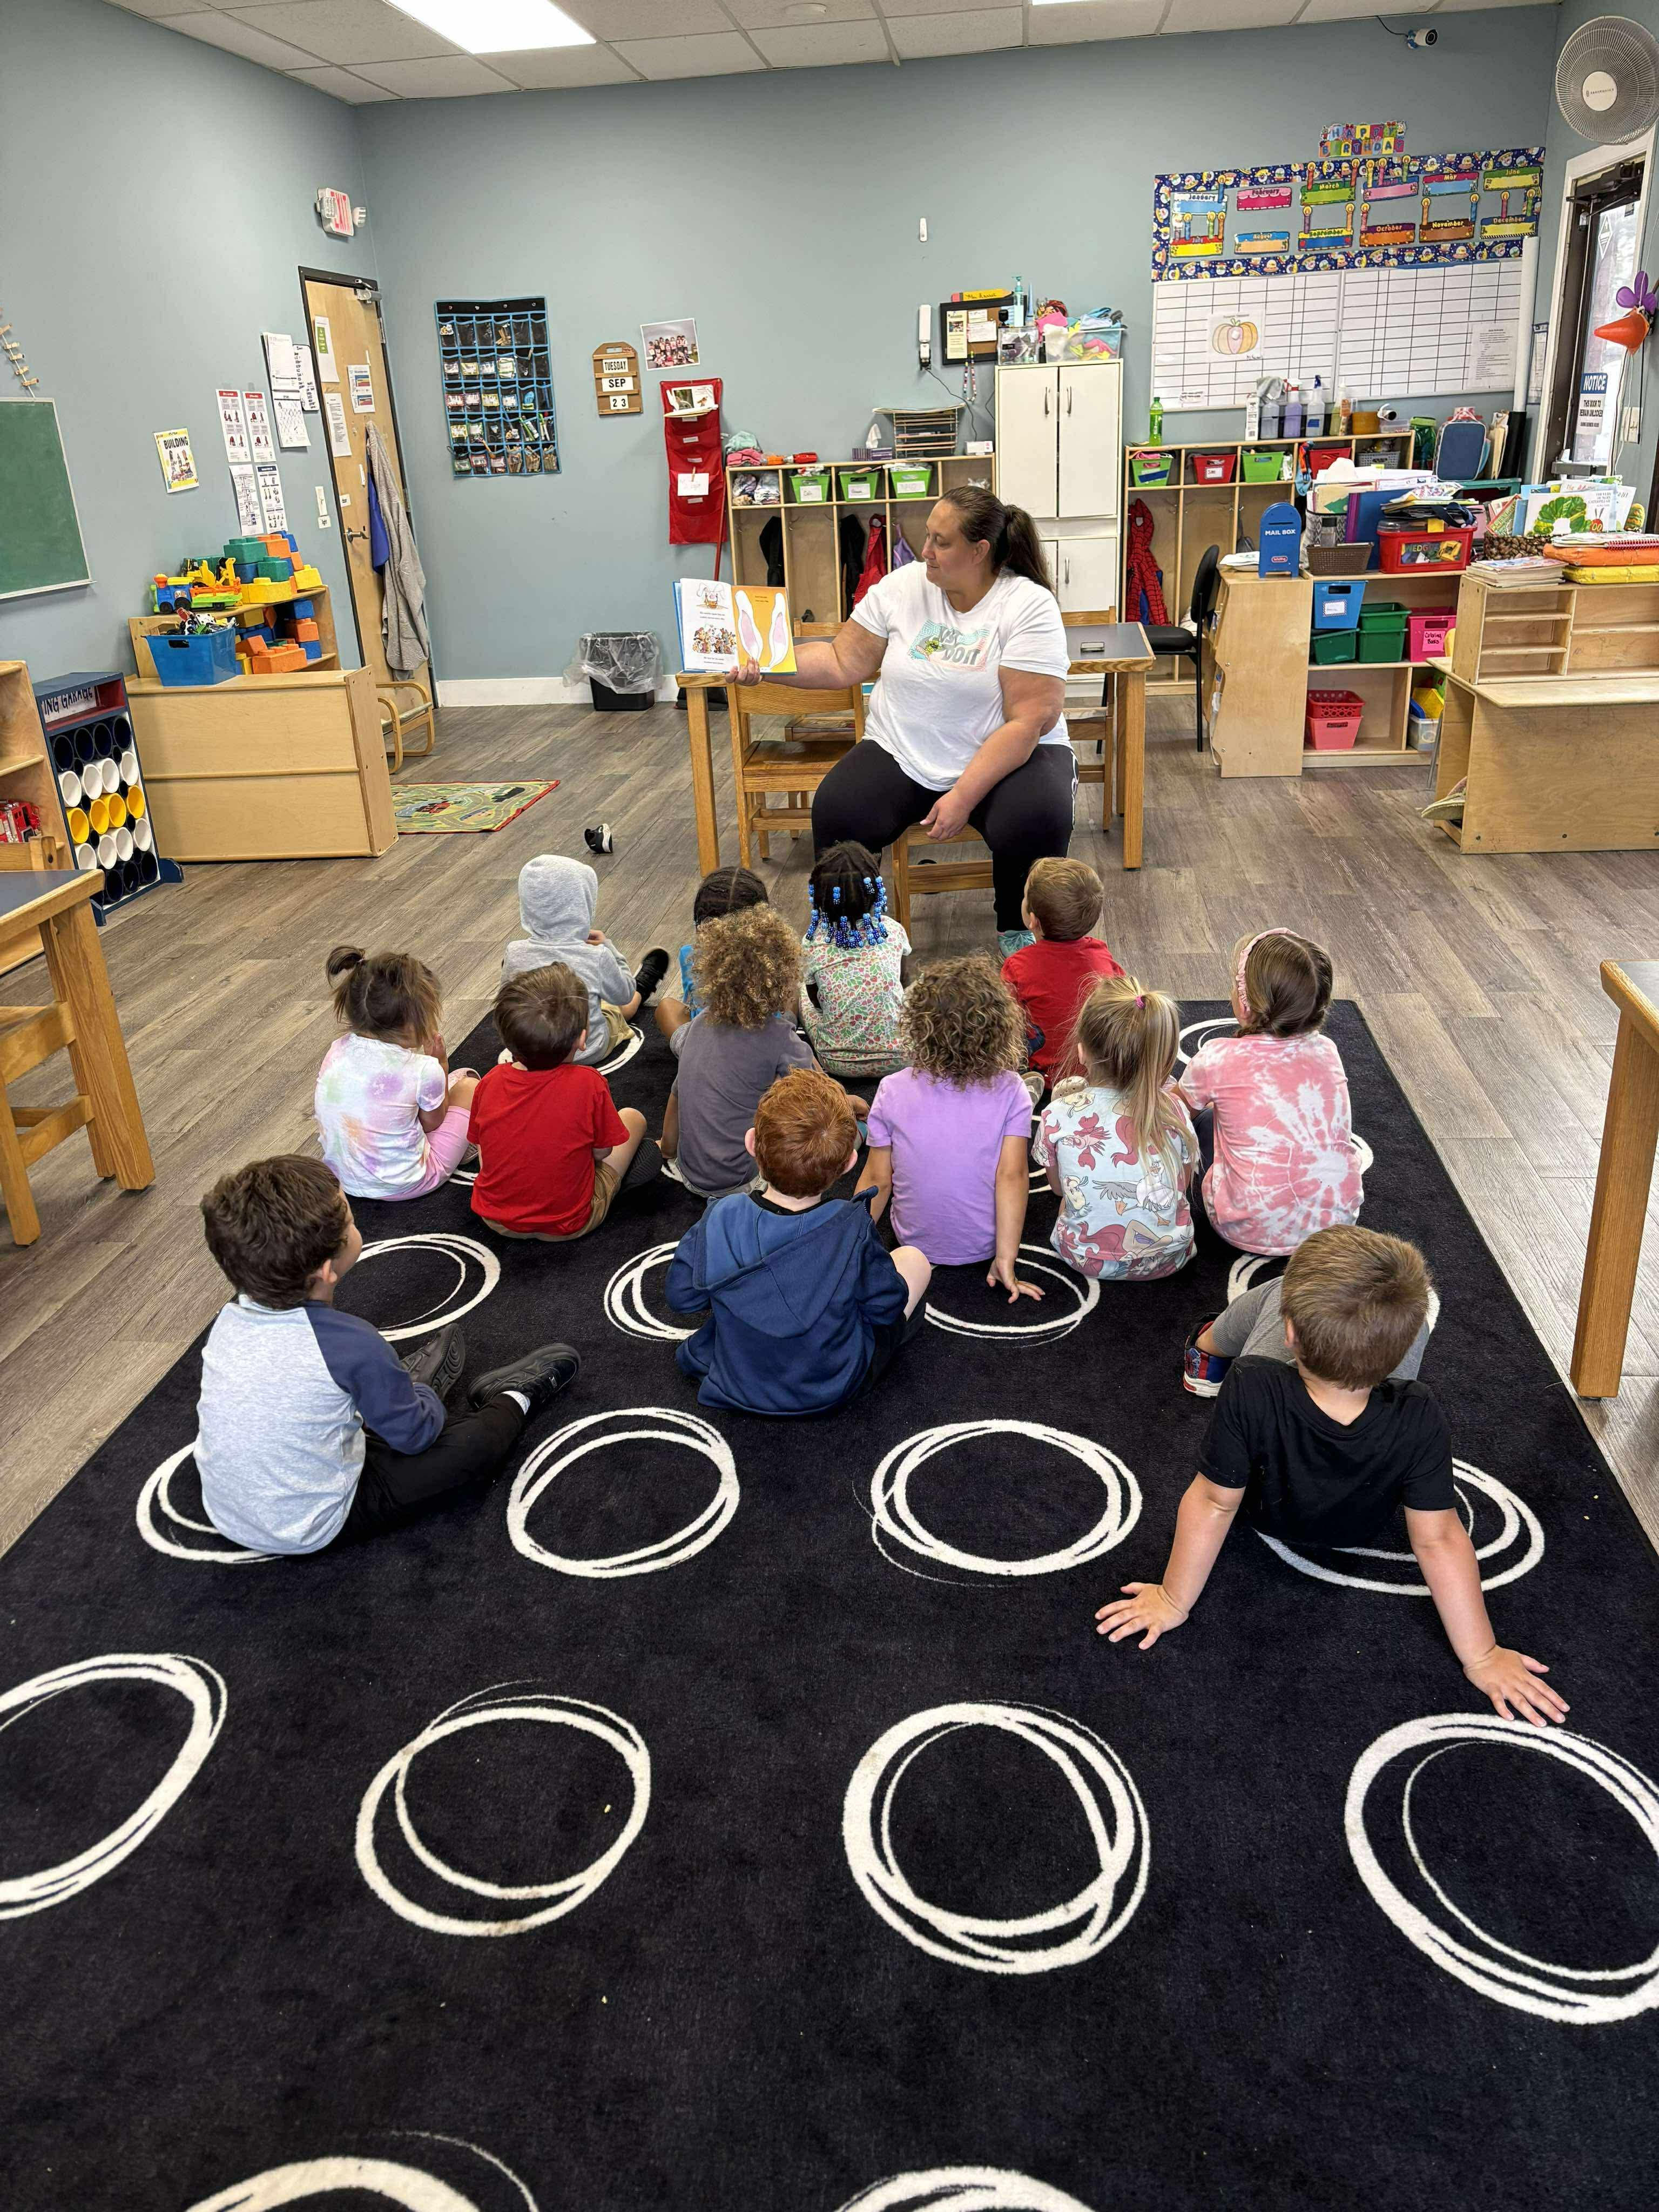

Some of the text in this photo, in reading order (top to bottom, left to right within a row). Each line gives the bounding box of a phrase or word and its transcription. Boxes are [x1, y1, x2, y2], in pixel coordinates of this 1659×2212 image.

[1332, 126, 1394, 138] HAPPY
[1323, 140, 1404, 156] BIRTHDAY
[1444, 173, 1457, 181] May
[1319, 182, 1339, 190] March
[1377, 224, 1402, 232] October
[1432, 220, 1464, 228] November
[605, 361, 626, 370] TUESDAY
[609, 378, 626, 388] SEP
[1583, 375, 1607, 391] NOTICE
[164, 436, 188, 450] BUILDING
[61, 687, 93, 709] GARAGE
